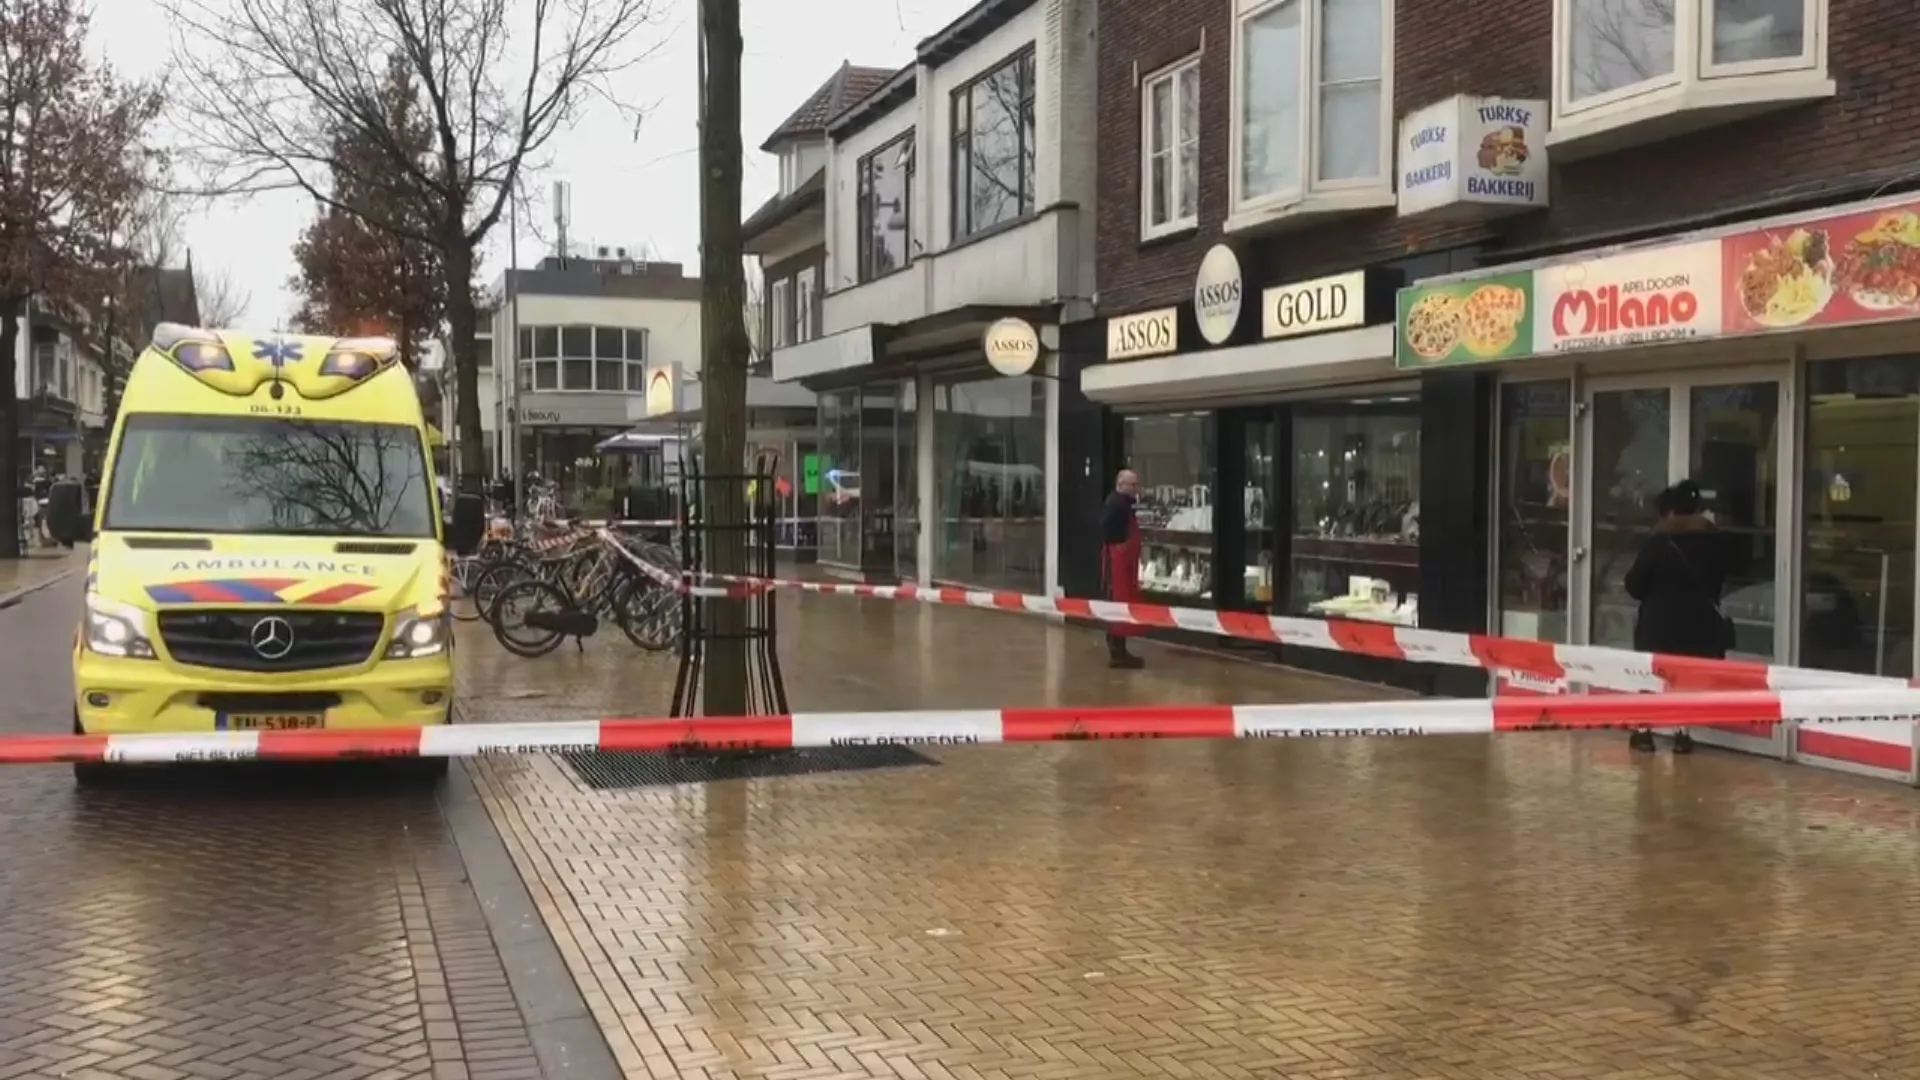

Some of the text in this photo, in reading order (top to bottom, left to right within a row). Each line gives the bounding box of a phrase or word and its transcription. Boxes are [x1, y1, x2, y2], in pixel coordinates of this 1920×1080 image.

[1478, 105, 1531, 126] TURKSE
[1410, 126, 1446, 151] TURKSE
[1405, 160, 1451, 188] BAKKERIJ
[1467, 176, 1534, 201] BAKKERIJ
[1199, 278, 1240, 309] ASSOS
[1622, 274, 1690, 294] APELDOORN
[1276, 284, 1348, 328] GOLD
[1552, 284, 1697, 336] Milano
[992, 340, 1033, 351] ASSOS
[1116, 316, 1171, 352] ASSOS
[172, 559, 376, 576] AMBULANCE
